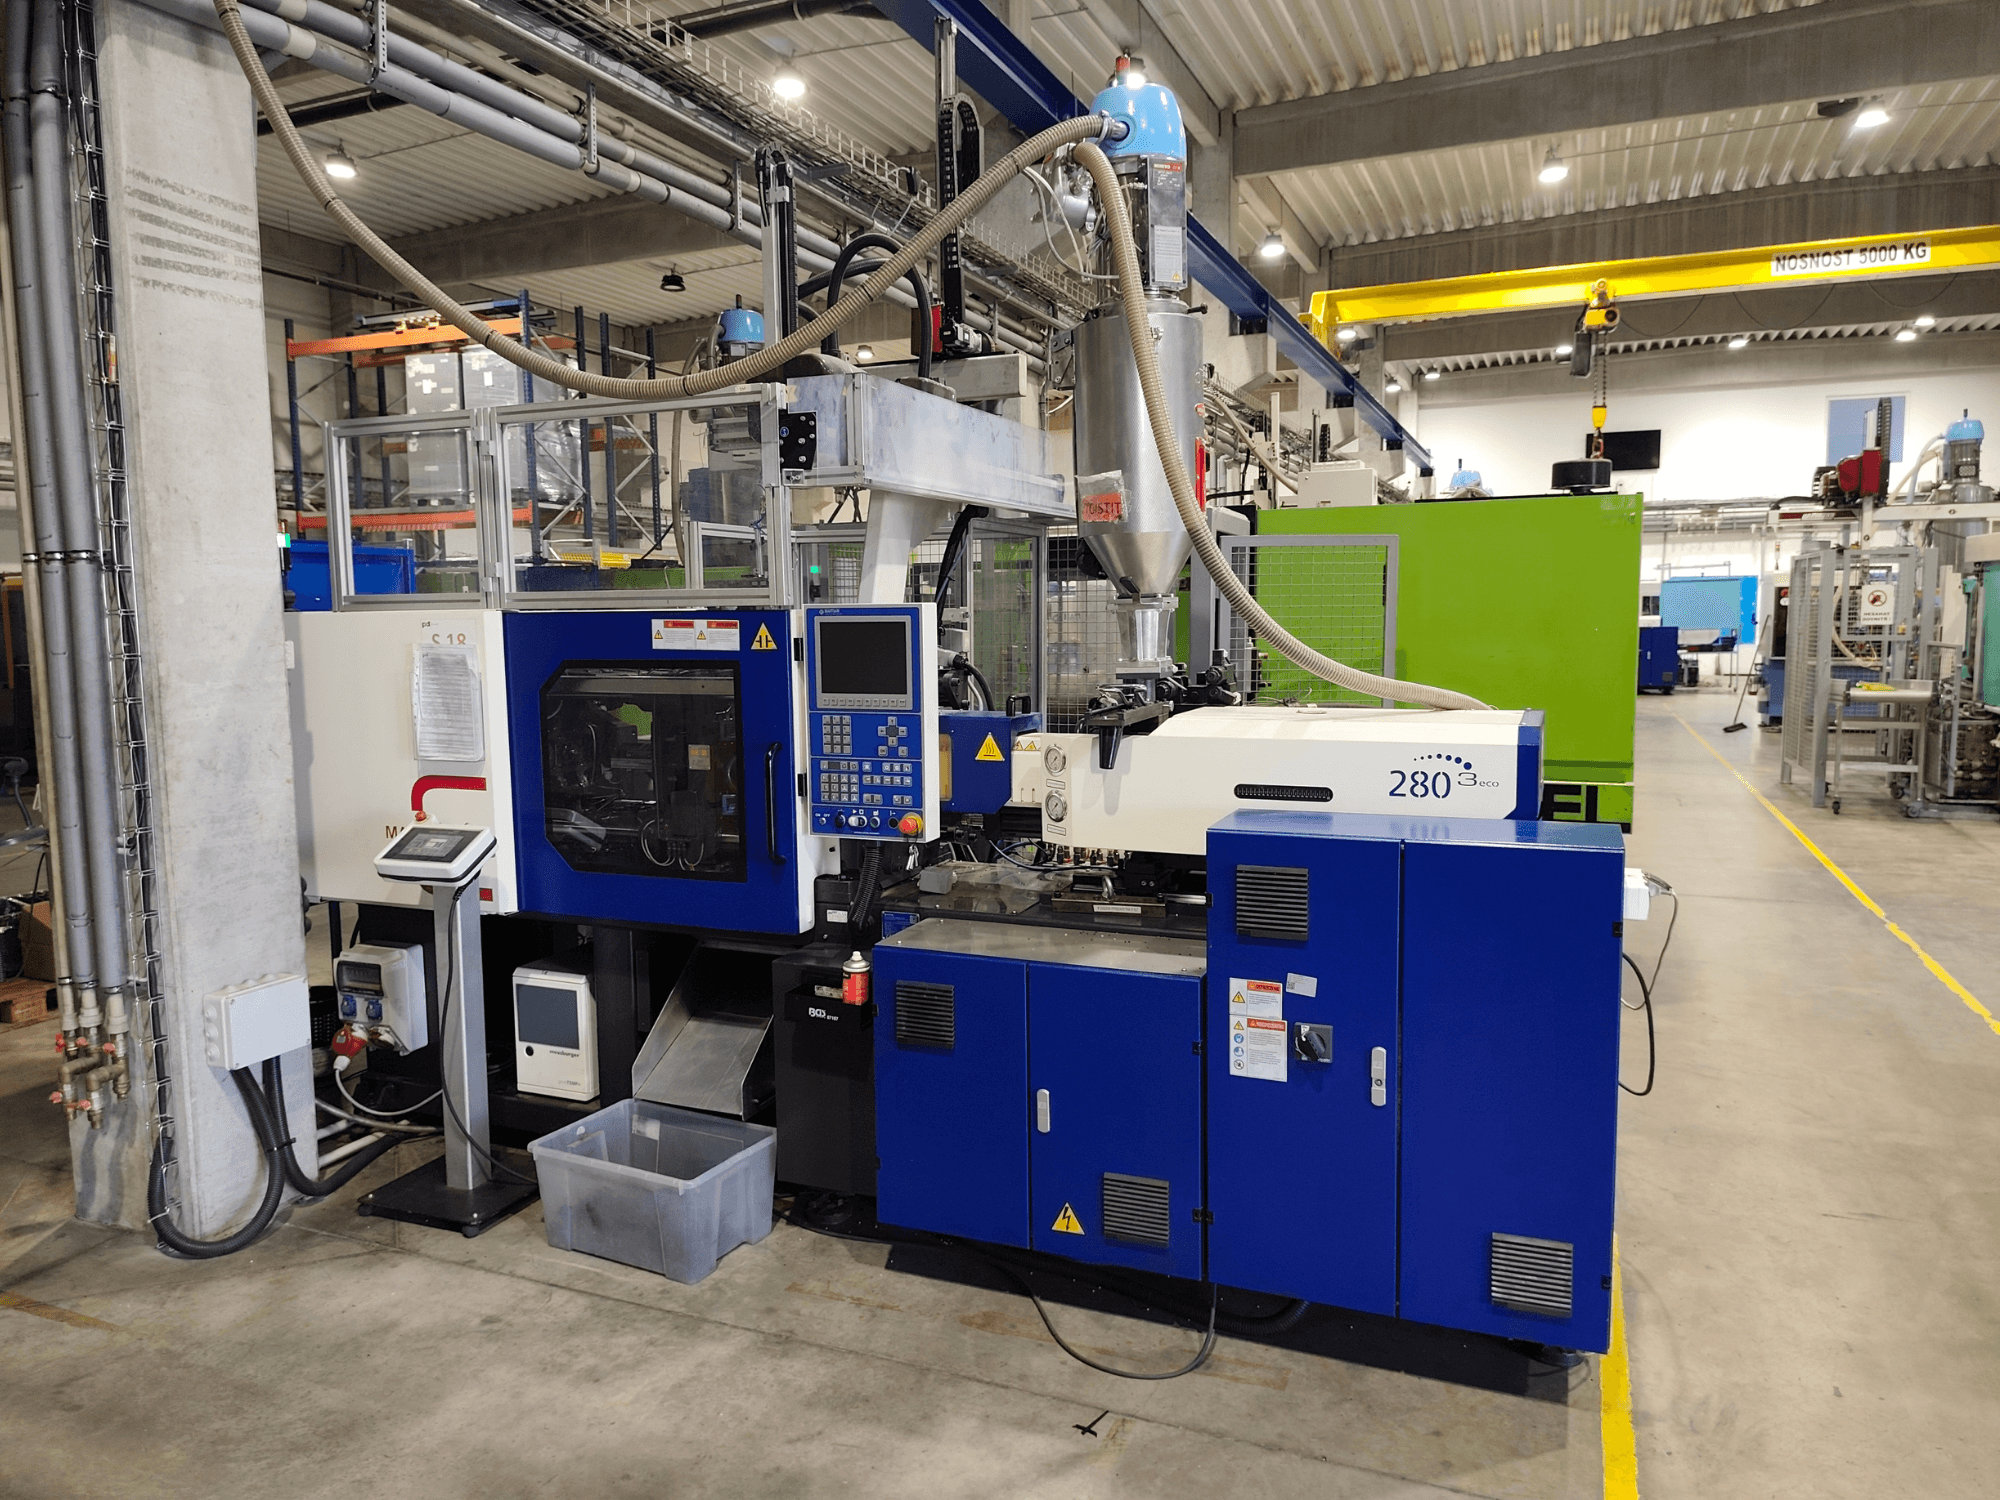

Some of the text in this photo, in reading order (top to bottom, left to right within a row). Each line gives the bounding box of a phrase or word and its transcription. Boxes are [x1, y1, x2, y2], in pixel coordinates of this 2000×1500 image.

[1775, 241, 1927, 272] NOSNOST 5000 KG
[432, 633, 466, 645] S 18
[1388, 769, 1452, 799] 280
